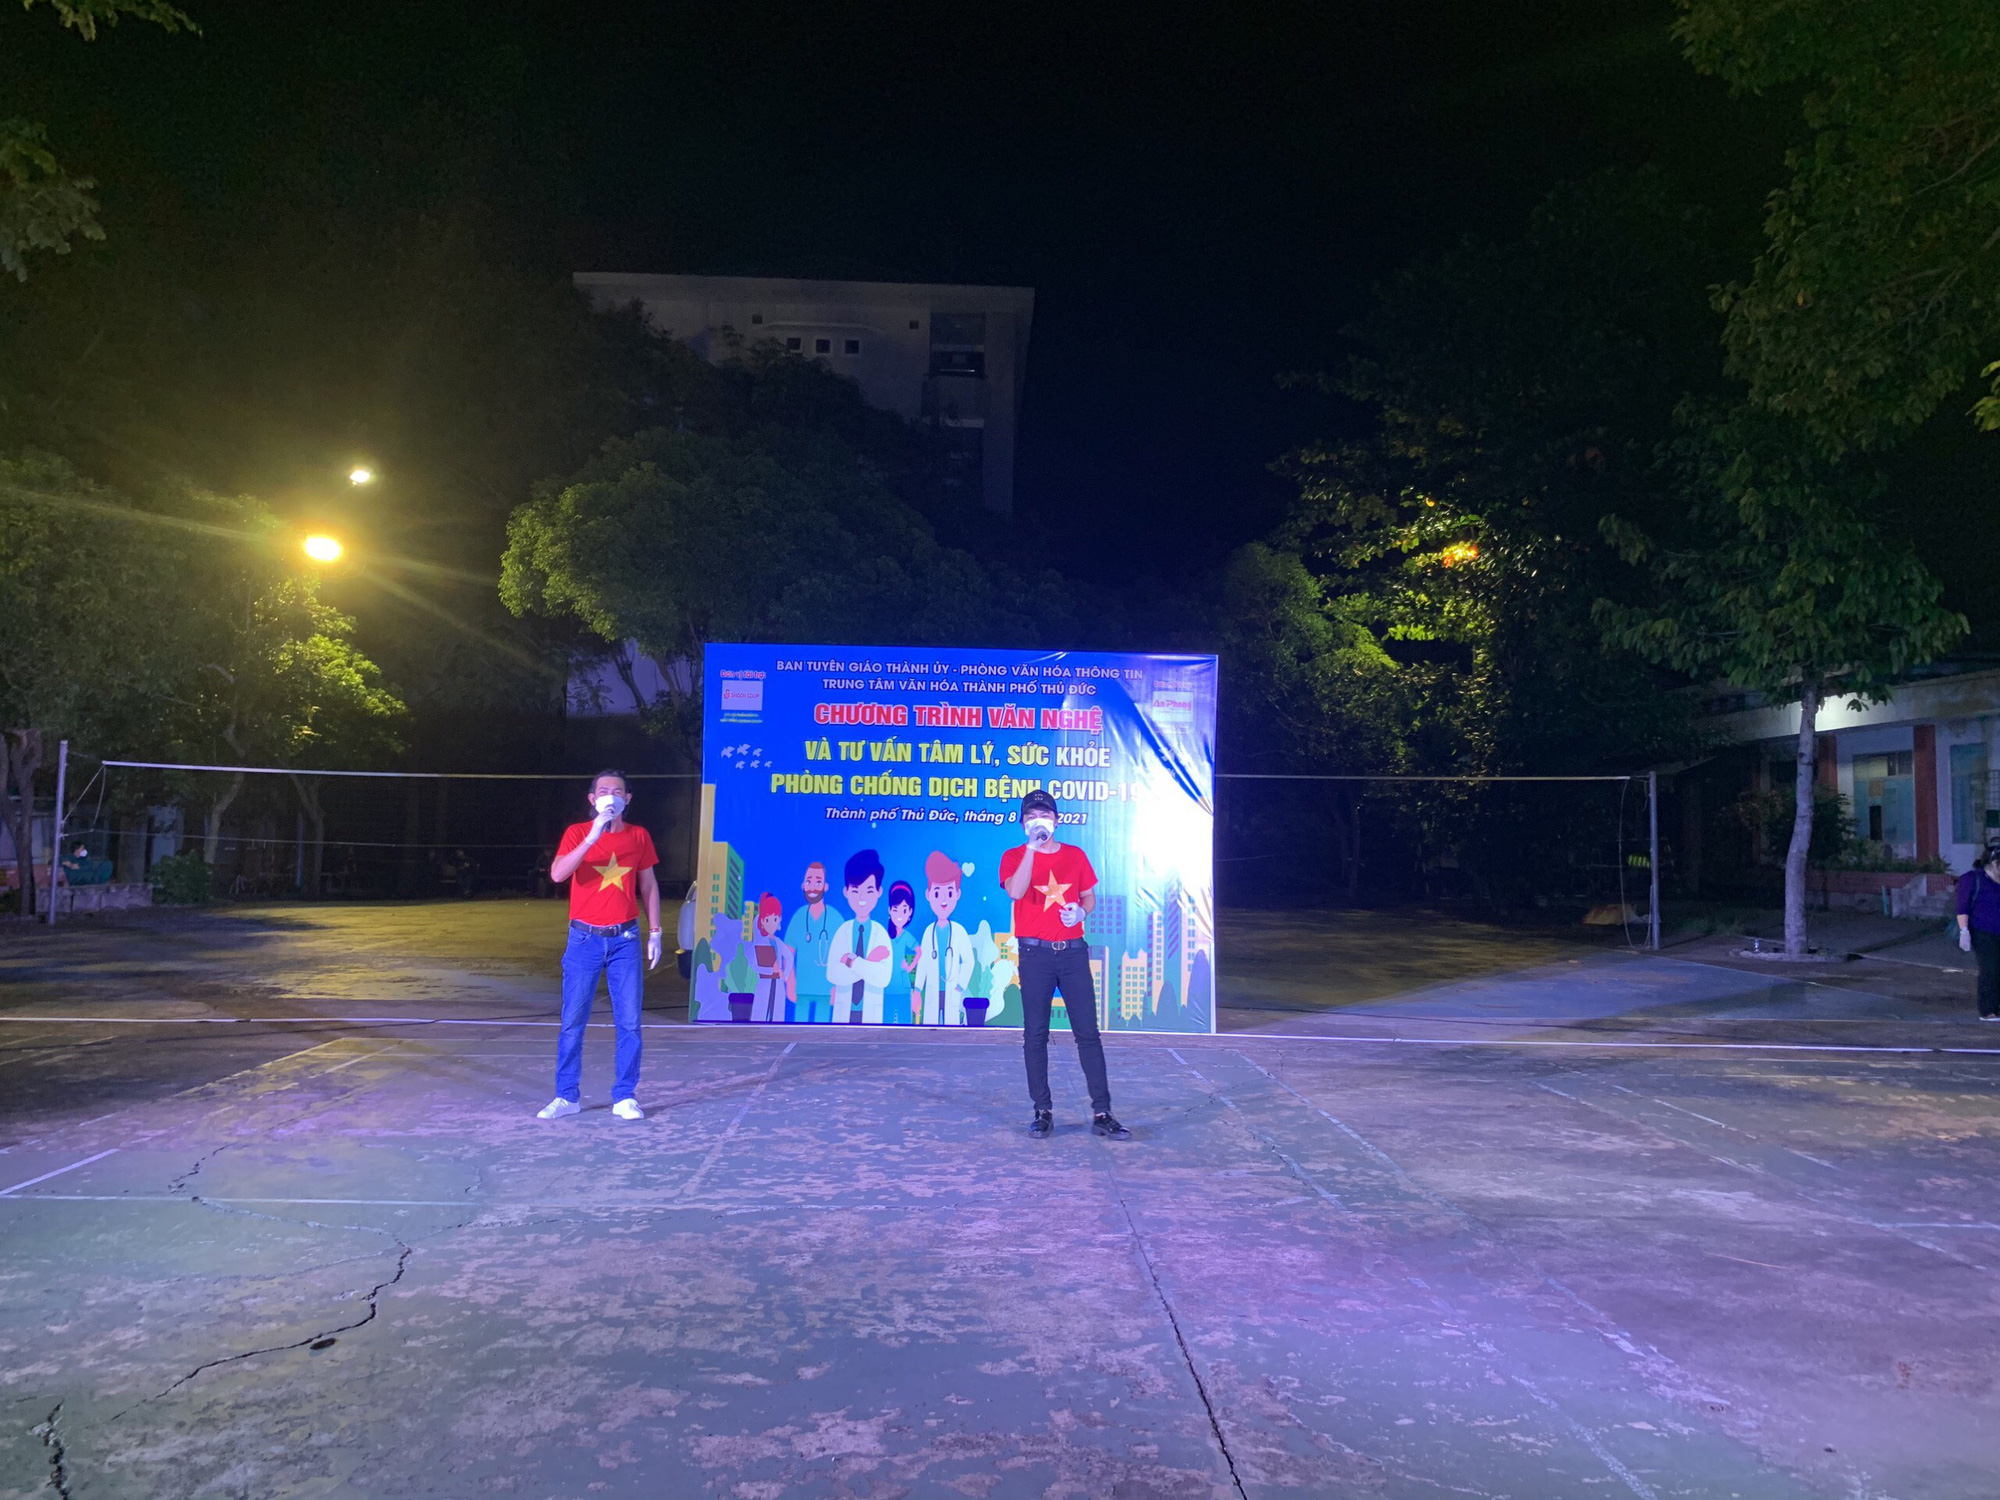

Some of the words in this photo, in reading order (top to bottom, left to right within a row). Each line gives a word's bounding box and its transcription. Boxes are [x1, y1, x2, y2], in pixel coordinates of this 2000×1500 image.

[776, 661, 803, 671] BAN
[807, 659, 845, 672] TUYÊN
[848, 660, 882, 673] GIÁO
[886, 661, 929, 674] THÀNH
[933, 661, 950, 674] ỦY
[961, 662, 1007, 676] PHÒNG
[1012, 664, 1038, 677] VĂN
[1043, 664, 1071, 677] HÓA
[1075, 666, 1120, 679] THÔNG
[1124, 669, 1142, 680] TIN
[823, 679, 865, 690] TRUNG
[868, 677, 894, 690] TÂM
[899, 678, 926, 691] VĂN
[930, 679, 959, 692] HÓA
[963, 679, 1005, 693] THÀNH
[1010, 680, 1037, 694] PHỐ
[1041, 681, 1064, 694] THỦ
[1069, 682, 1096, 695] ĐỨC
[814, 702, 908, 726] CHƯƠNG
[914, 701, 983, 727] TRÌNH
[988, 703, 1036, 729] VĂN
[1041, 706, 1103, 735] NGHỆ
[805, 736, 832, 761] VÀ
[838, 740, 866, 761] TƯ
[870, 736, 912, 762] VẤN
[918, 739, 963, 763] TÂM
[971, 741, 1000, 767] LÝ,
[1007, 742, 1049, 766] SỨC
[1056, 741, 1111, 767] KHỎE
[771, 769, 843, 794] PHÒNG
[850, 769, 922, 796] CHỐNG
[928, 776, 978, 801] DỊCH
[825, 807, 866, 819] Thành
[870, 807, 899, 821] phố
[902, 808, 924, 820] Thủ
[929, 808, 959, 823] Đức,
[964, 810, 1003, 823] tháng
[1008, 811, 1017, 822] 8
[1057, 813, 1088, 824] 2021
